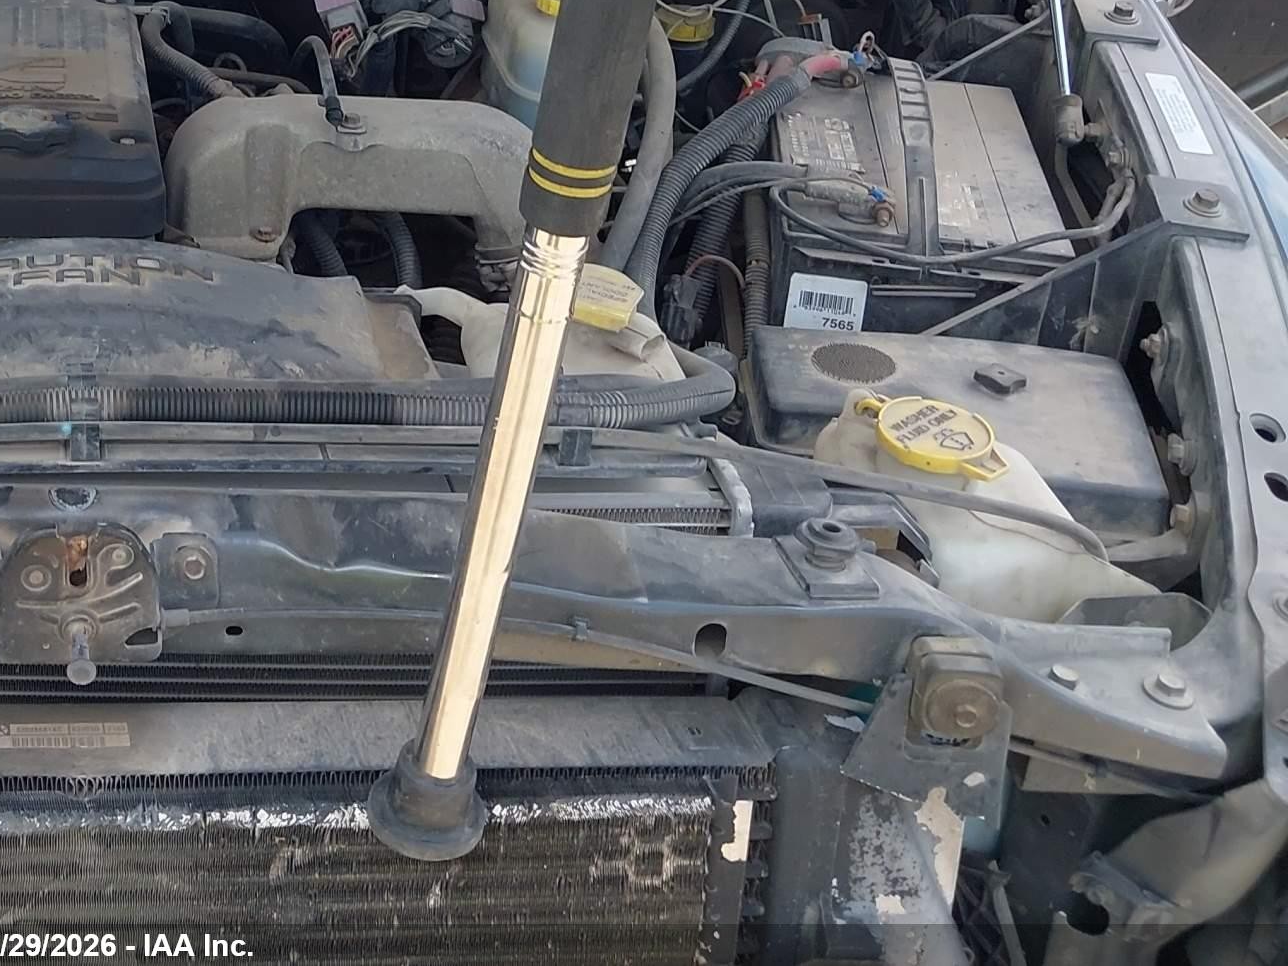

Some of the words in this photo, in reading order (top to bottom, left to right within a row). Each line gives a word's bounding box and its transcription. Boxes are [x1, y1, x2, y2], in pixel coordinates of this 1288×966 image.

[12, 265, 142, 287] FAN
[821, 316, 856, 331] 7565
[889, 404, 940, 432] WASHER
[896, 424, 931, 445] FLUID
[927, 408, 958, 427] ONLY
